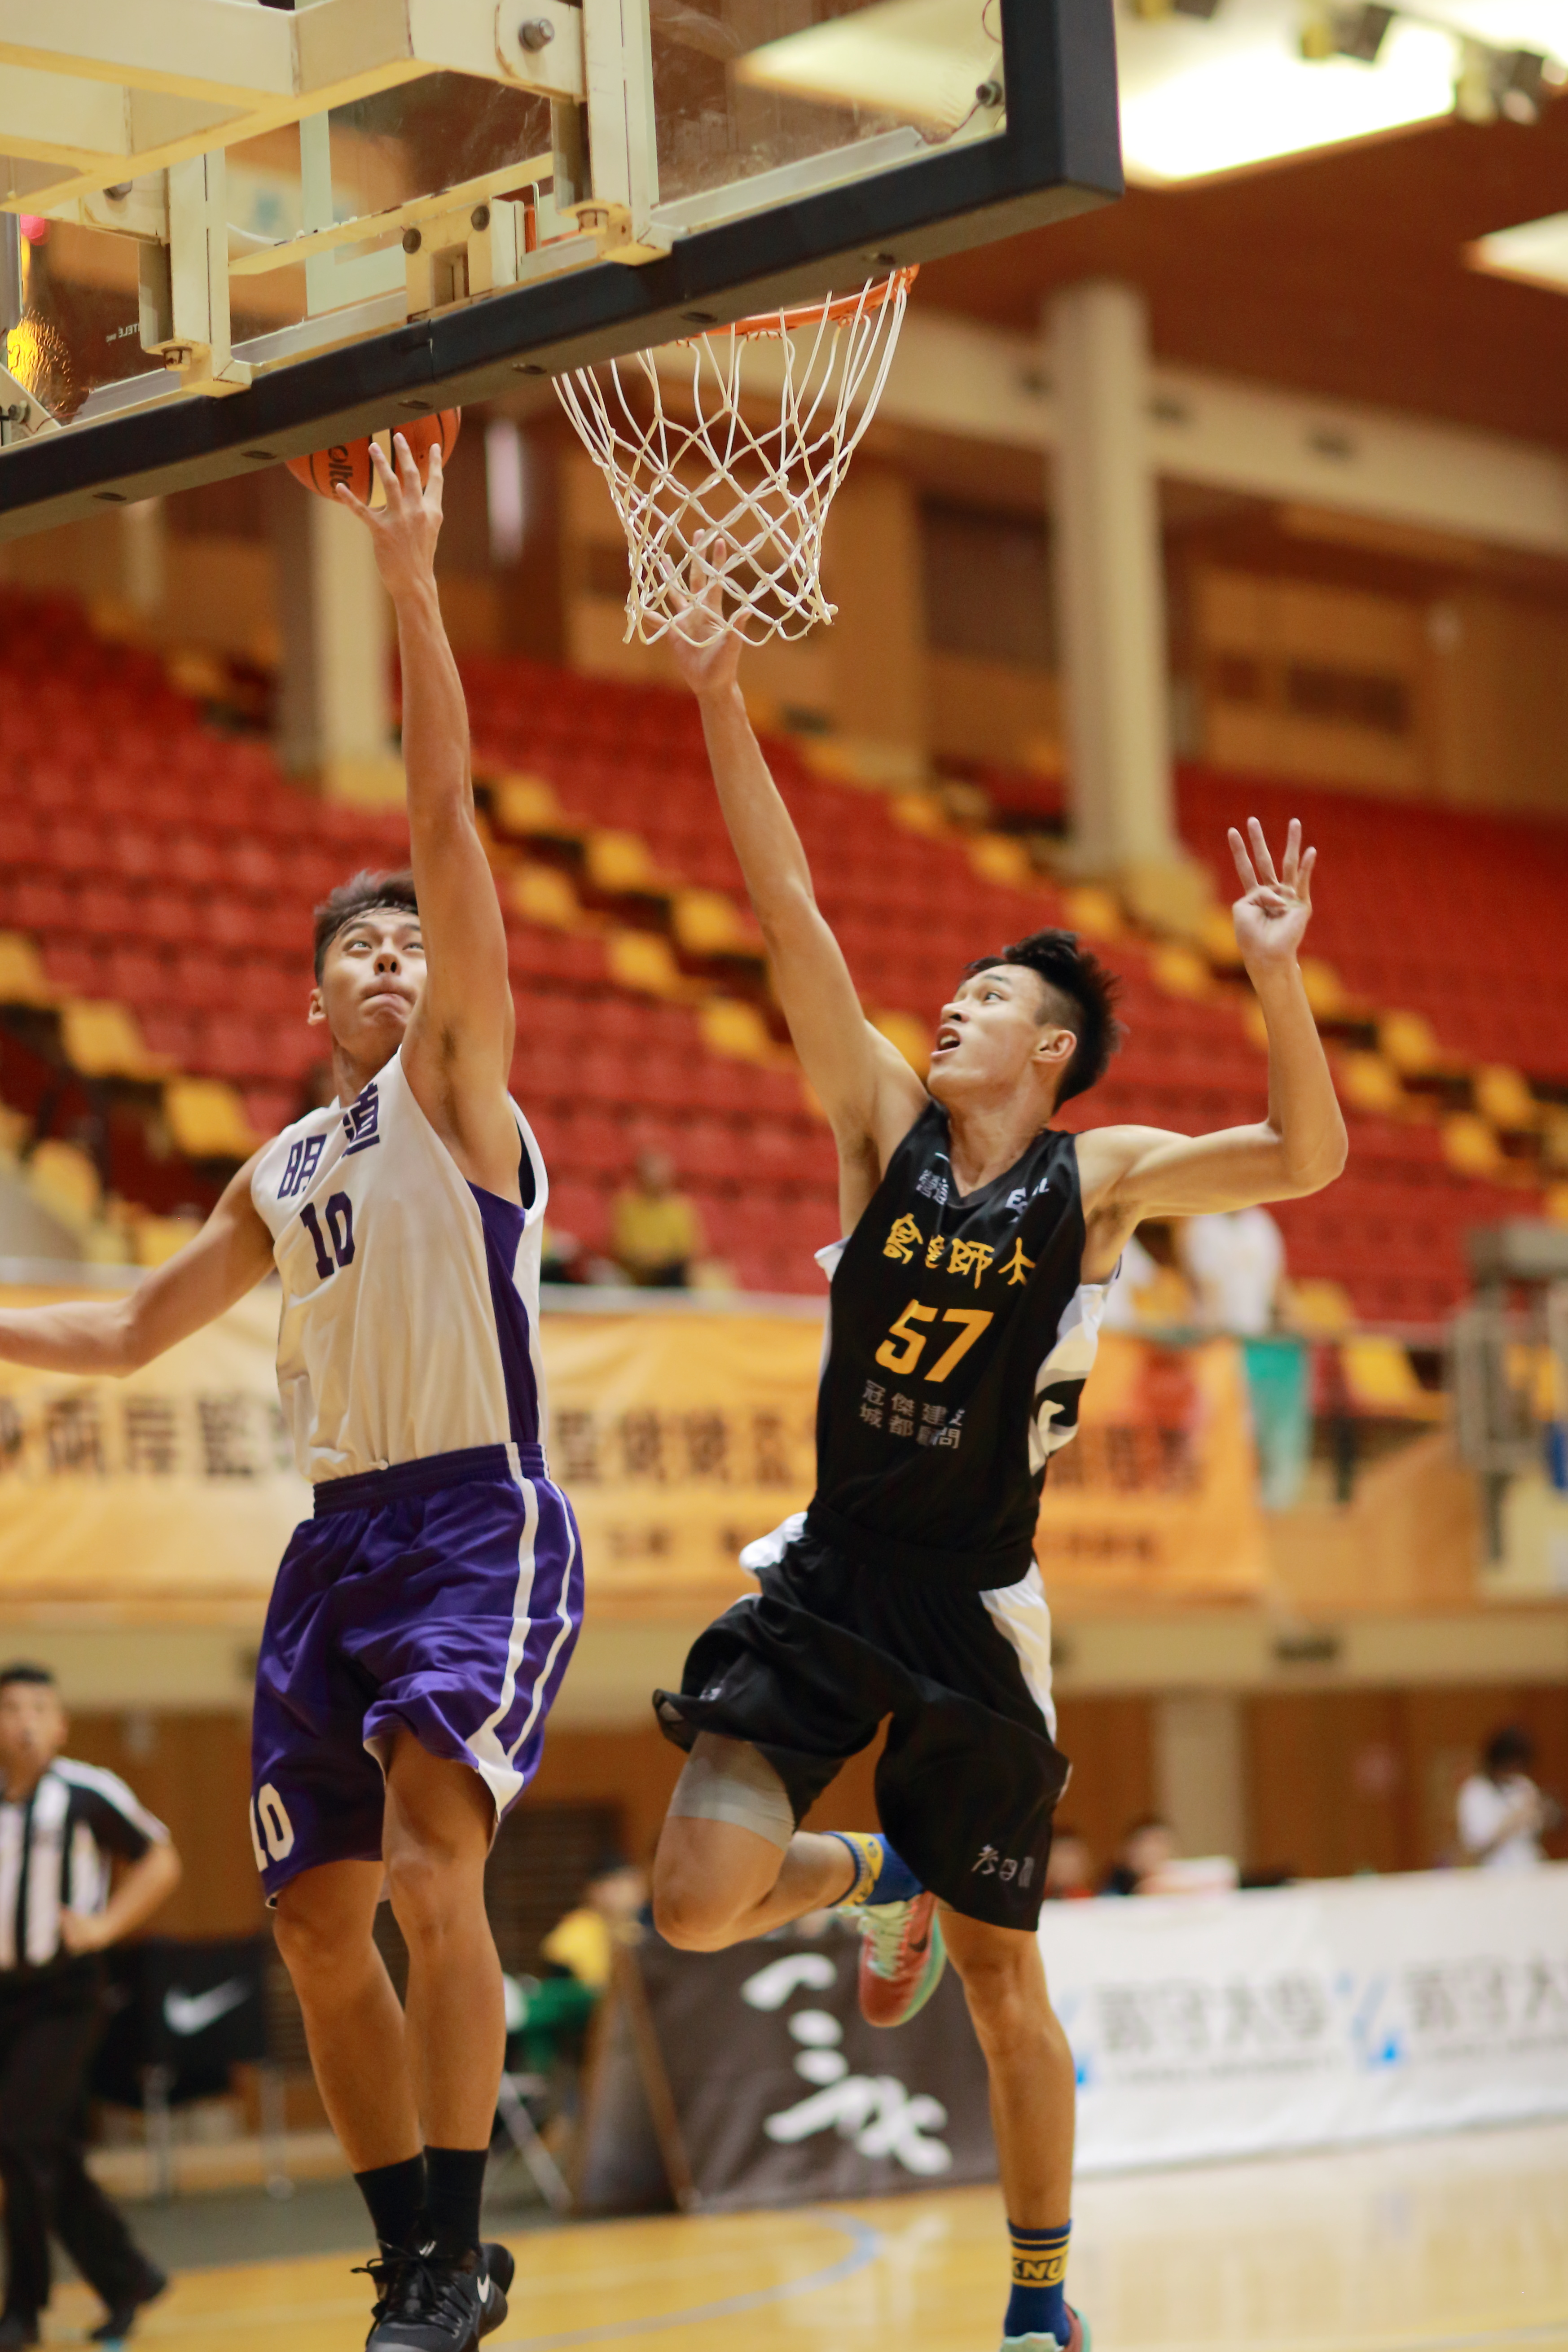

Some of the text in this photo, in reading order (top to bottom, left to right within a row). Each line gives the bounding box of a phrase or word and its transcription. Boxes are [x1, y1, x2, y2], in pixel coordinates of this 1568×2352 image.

[300, 1191, 355, 1280] 10
[875, 1299, 994, 1382] 57
[249, 1782, 294, 1873] 10
